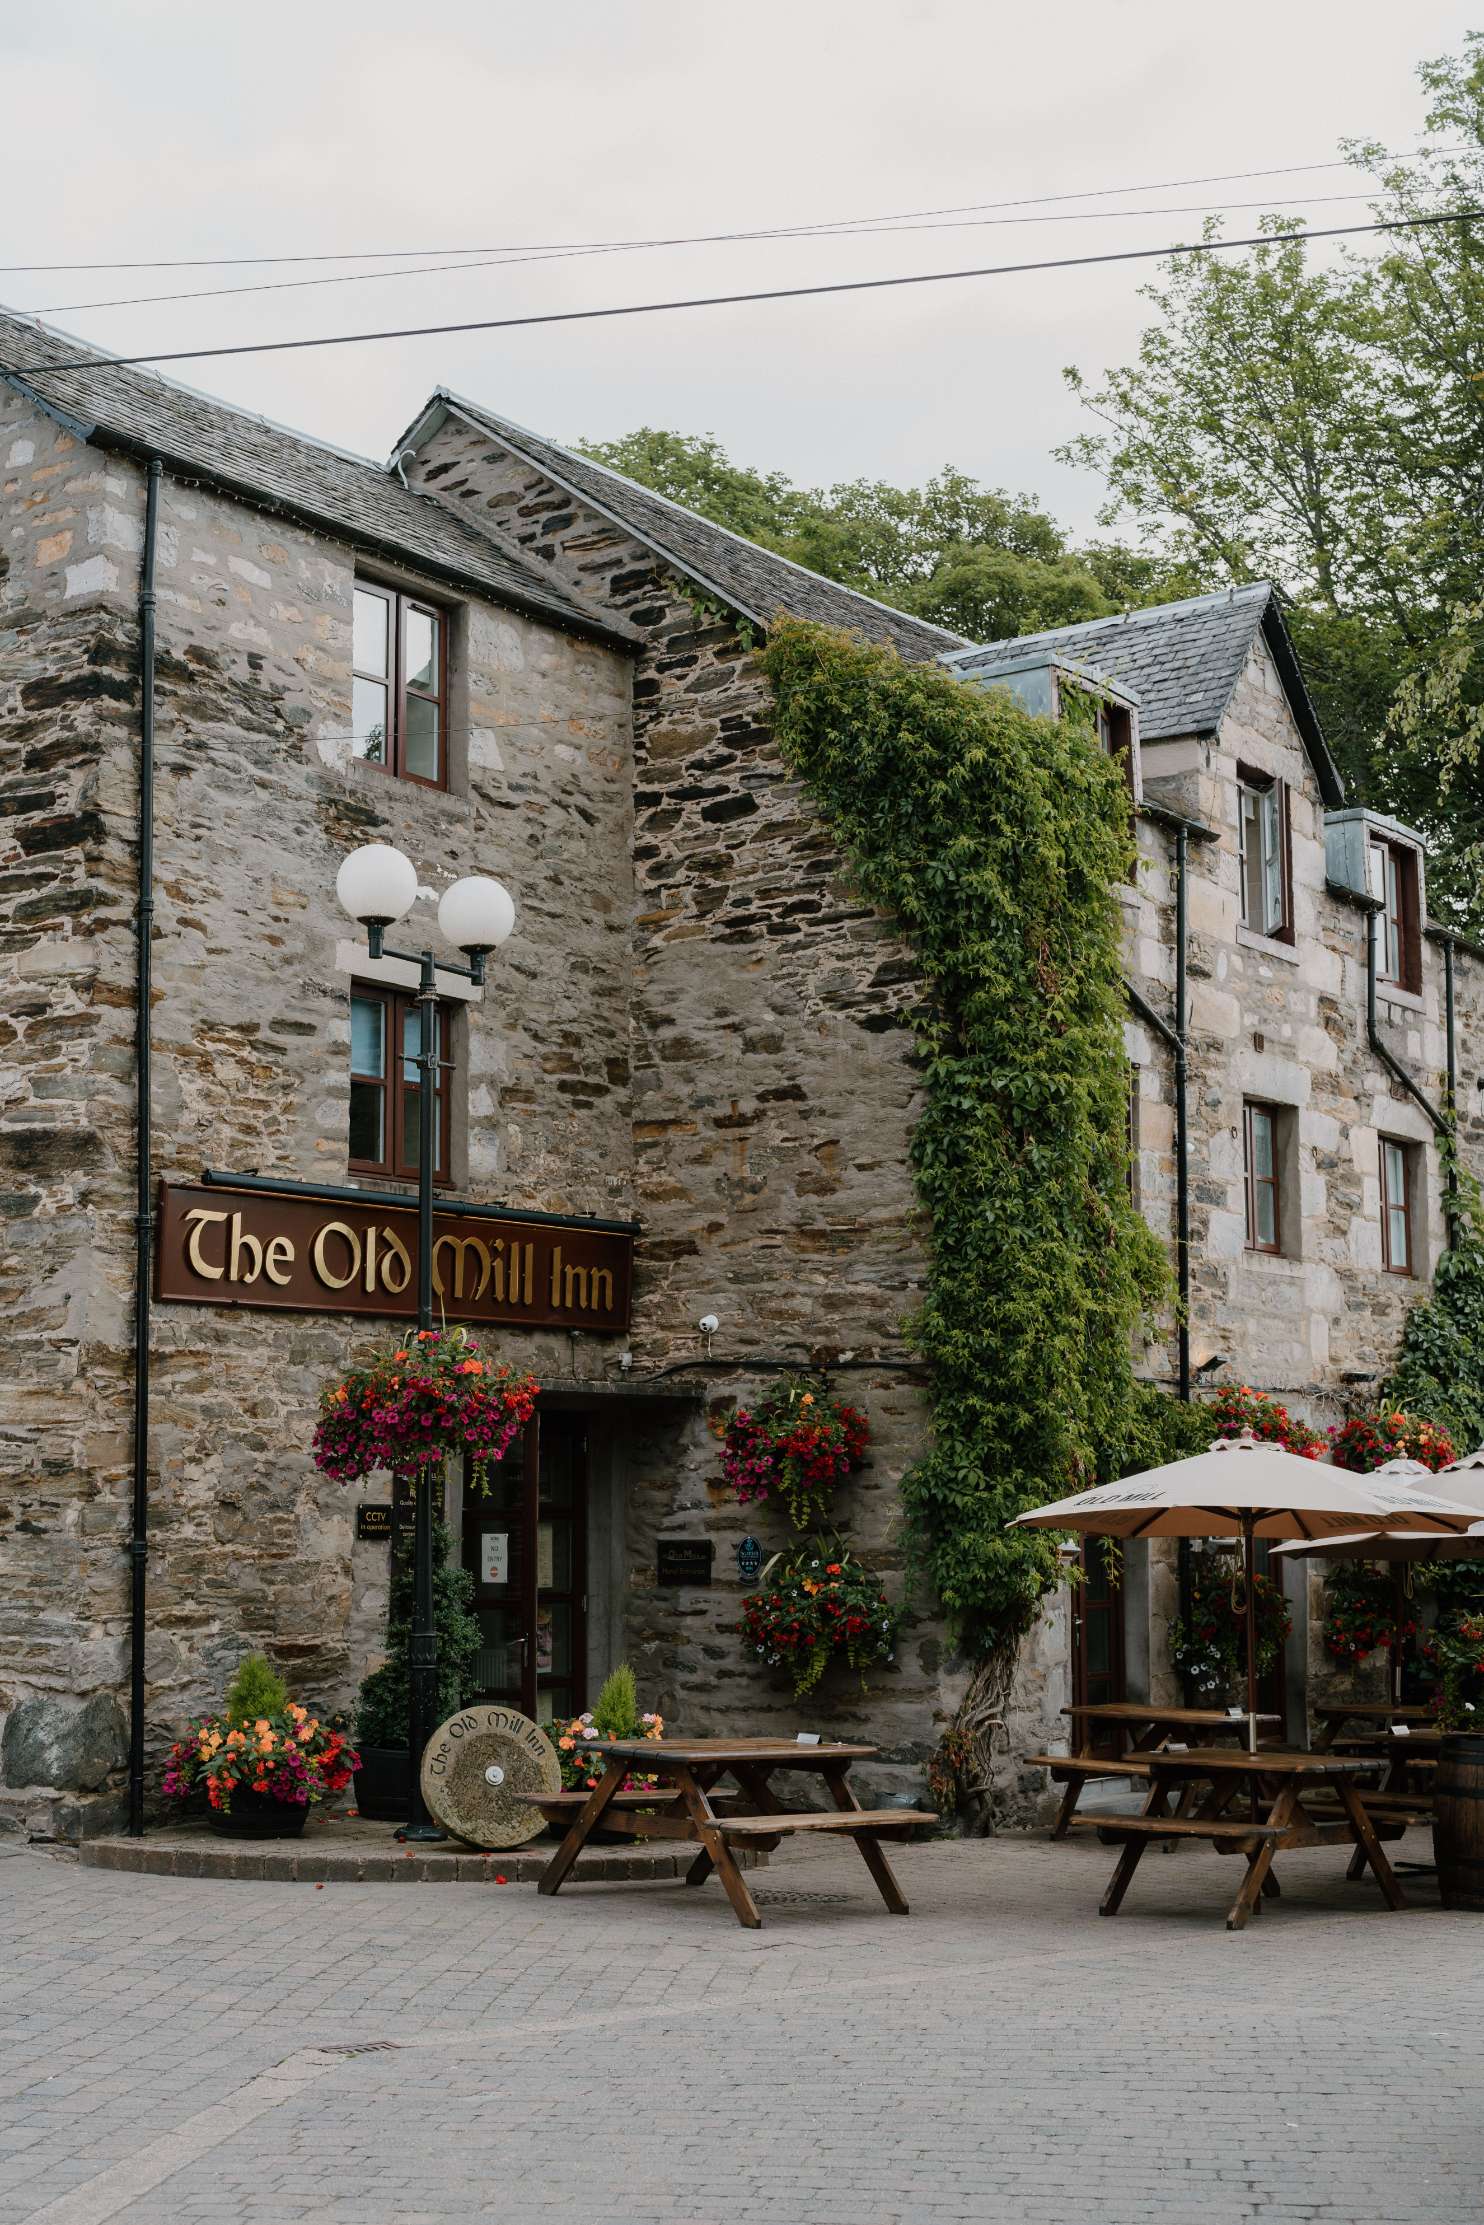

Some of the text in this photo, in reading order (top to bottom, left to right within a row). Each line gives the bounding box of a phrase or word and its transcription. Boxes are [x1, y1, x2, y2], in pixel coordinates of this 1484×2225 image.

[184, 1208, 615, 1311] The Old Mill Inn
[365, 1511, 387, 1522] CCTV
[366, 1522, 392, 1531] operation
[430, 1711, 546, 1776] The Old Mill Inn
